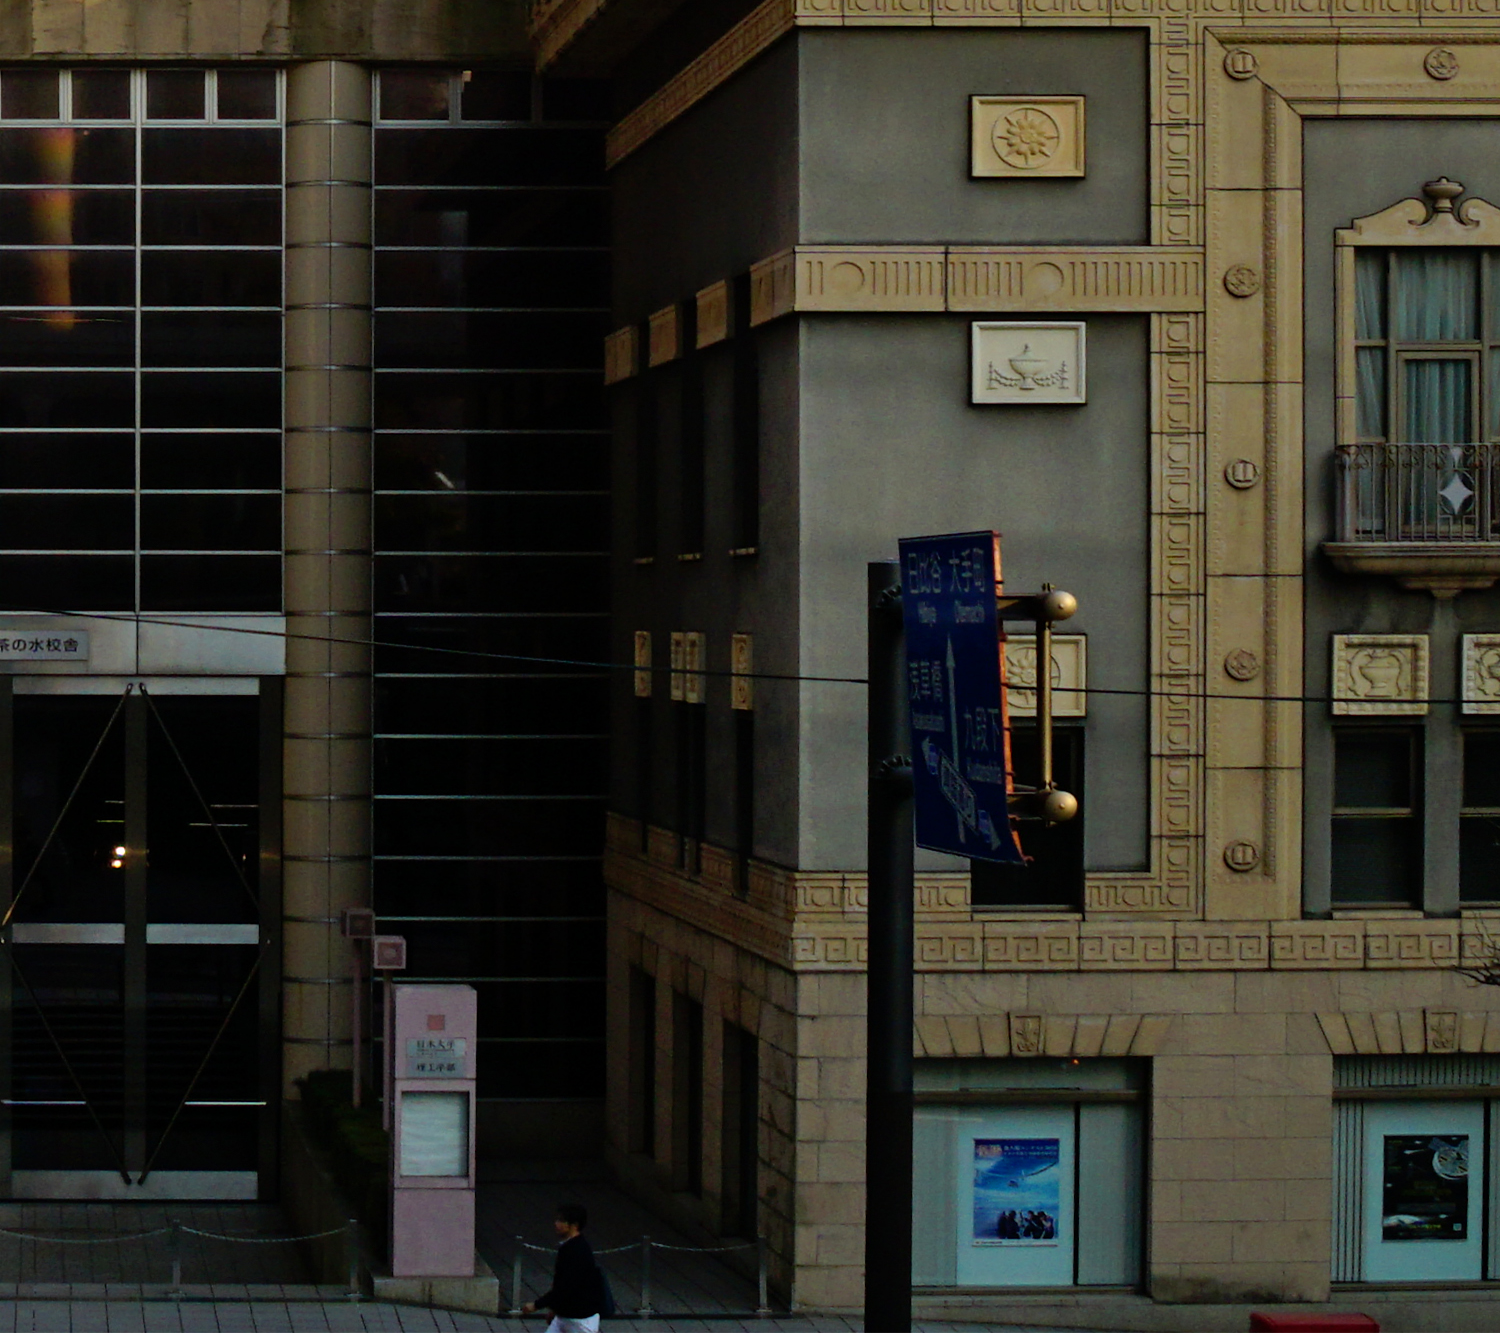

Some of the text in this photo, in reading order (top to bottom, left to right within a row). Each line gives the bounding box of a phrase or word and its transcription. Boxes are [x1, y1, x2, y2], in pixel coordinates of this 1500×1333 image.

[908, 547, 985, 594] 日比谷 大手町
[963, 705, 1000, 752] 九段下
